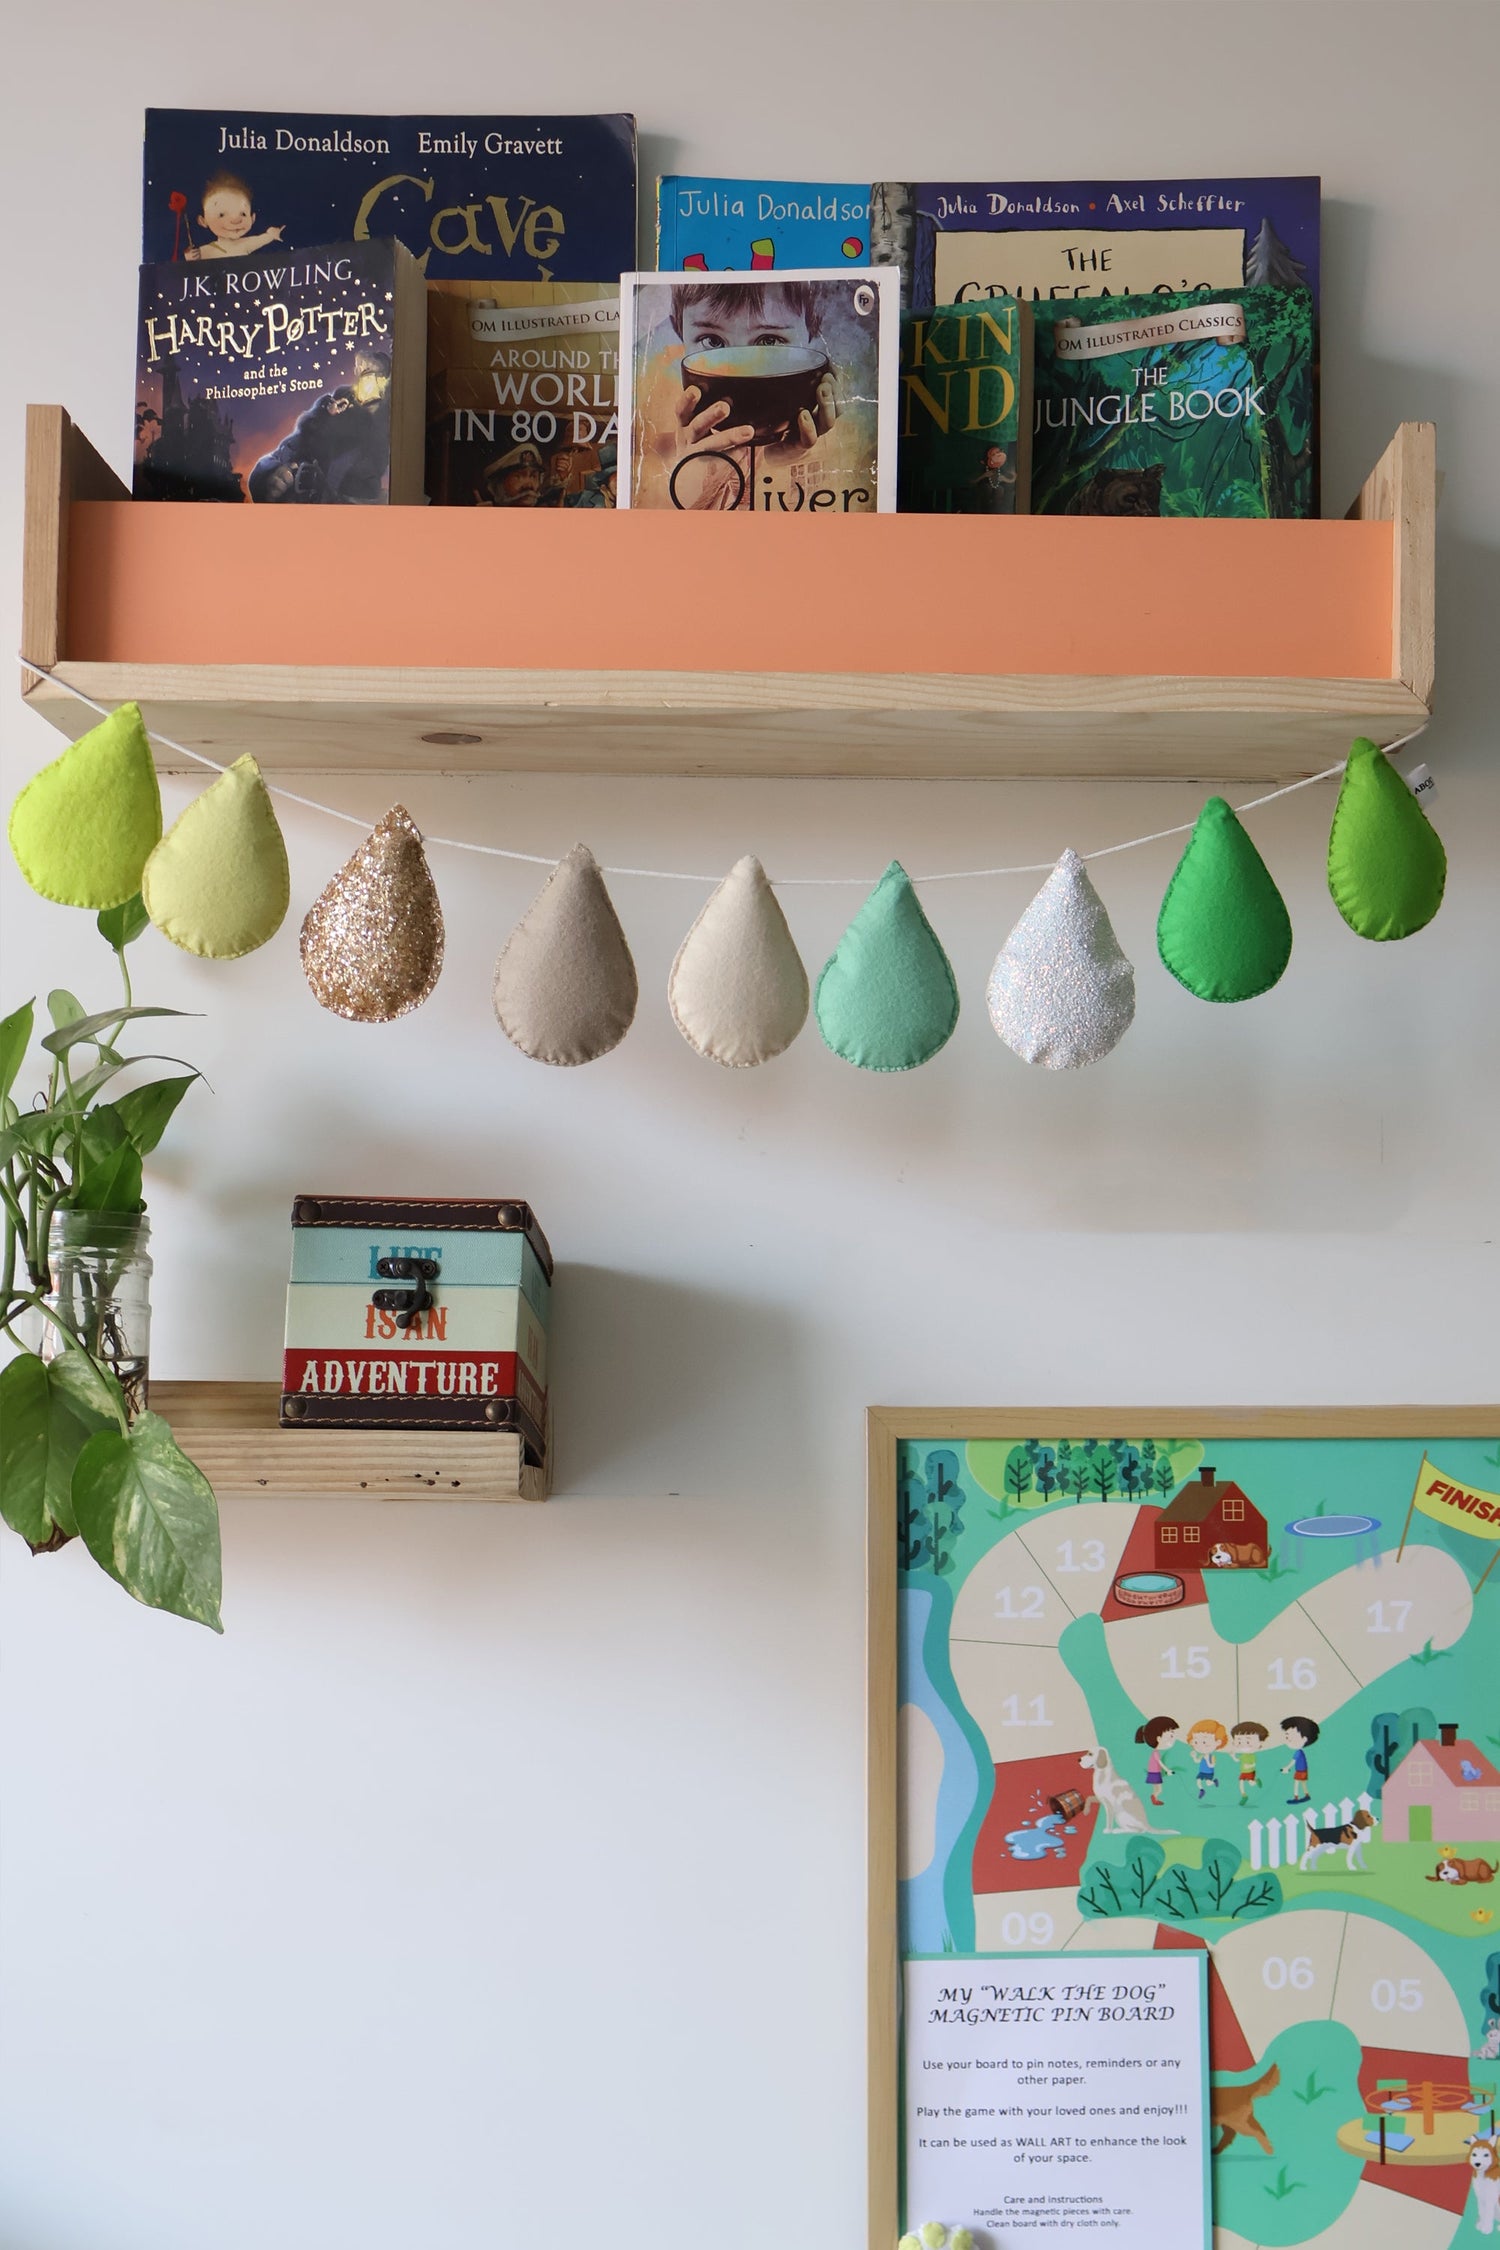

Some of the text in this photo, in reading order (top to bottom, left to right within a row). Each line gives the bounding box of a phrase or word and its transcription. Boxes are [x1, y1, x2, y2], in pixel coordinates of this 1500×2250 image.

[219, 127, 391, 153] Julia Donaldson
[418, 131, 563, 158] Emily Gravett
[678, 190, 744, 217] Julia
[936, 193, 1081, 219] Julia Donaldson
[1106, 191, 1247, 214] Axel Scheffler
[354, 174, 565, 275] Cave
[1061, 246, 1113, 271] THE
[180, 259, 352, 301] J.K. ROWLING
[145, 313, 264, 363] HARRY
[472, 319, 496, 333] OM
[910, 306, 1017, 368] KIN
[1057, 338, 1082, 351] OM
[244, 363, 288, 380] and the
[490, 349, 590, 370] AROUND
[206, 377, 323, 400] Philosopher's Stone
[1131, 366, 1168, 387] THE
[1033, 385, 1267, 434] JUNGLE BOOK
[454, 409, 495, 442] IN
[511, 410, 557, 443] 80
[669, 445, 870, 513] Oliver
[363, 1303, 397, 1340] IS
[299, 1359, 499, 1396] ADVENTURE
[1055, 1540, 1107, 1572] 13
[994, 1587, 1045, 1619] 12
[1366, 1600, 1413, 1633] 17
[1159, 1646, 1212, 1680] 15
[1266, 1657, 1317, 1691] 16
[1000, 1694, 1054, 1727] 11
[1000, 1913, 1055, 1945] 09
[1262, 1956, 1315, 1991] 06
[937, 1986, 973, 2003] MY
[980, 1984, 1057, 2002] “WALK
[1061, 1983, 1107, 2001] THE
[1370, 1978, 1424, 2013] 05
[927, 2005, 1175, 2027] MAGNETIC PIN BOARD
[922, 2059, 944, 2070] Use
[946, 2061, 973, 2072] your
[975, 2058, 1009, 2070] board
[1011, 2059, 1024, 2069] to
[1026, 2058, 1045, 2071] pin
[1085, 2057, 1143, 2069] reminders
[1145, 2059, 1158, 2068] or
[1160, 2059, 1182, 2070] any
[1016, 2074, 1087, 2087] other paper.
[916, 2106, 940, 2119] Play
[942, 2106, 962, 2117] the
[964, 2108, 996, 2119] game
[998, 2106, 1024, 2117] with
[1026, 2108, 1053, 2119] your
[1055, 2105, 1087, 2116] loved
[1088, 2107, 1117, 2116] ones
[1118, 2104, 1141, 2116] and
[918, 2135, 1188, 2148] It can be used as WALL ART to enhance the look
[1013, 2152, 1026, 2164] of
[1027, 2154, 1054, 2166] your
[973, 2207, 1004, 2217] Handle
[1004, 2207, 1020, 2216] the
[1021, 2207, 1061, 2218] magnetic
[1062, 2207, 1090, 2218] pieces
[1091, 2207, 1112, 2215] with
[1003, 2195, 1104, 2205] Care and instructions
[986, 2219, 1010, 2228] Clean
[1012, 2219, 1038, 2228] board
[1039, 2219, 1059, 2228] with
[1060, 2219, 1075, 2229] dry
[1076, 2219, 1099, 2228] cloth
